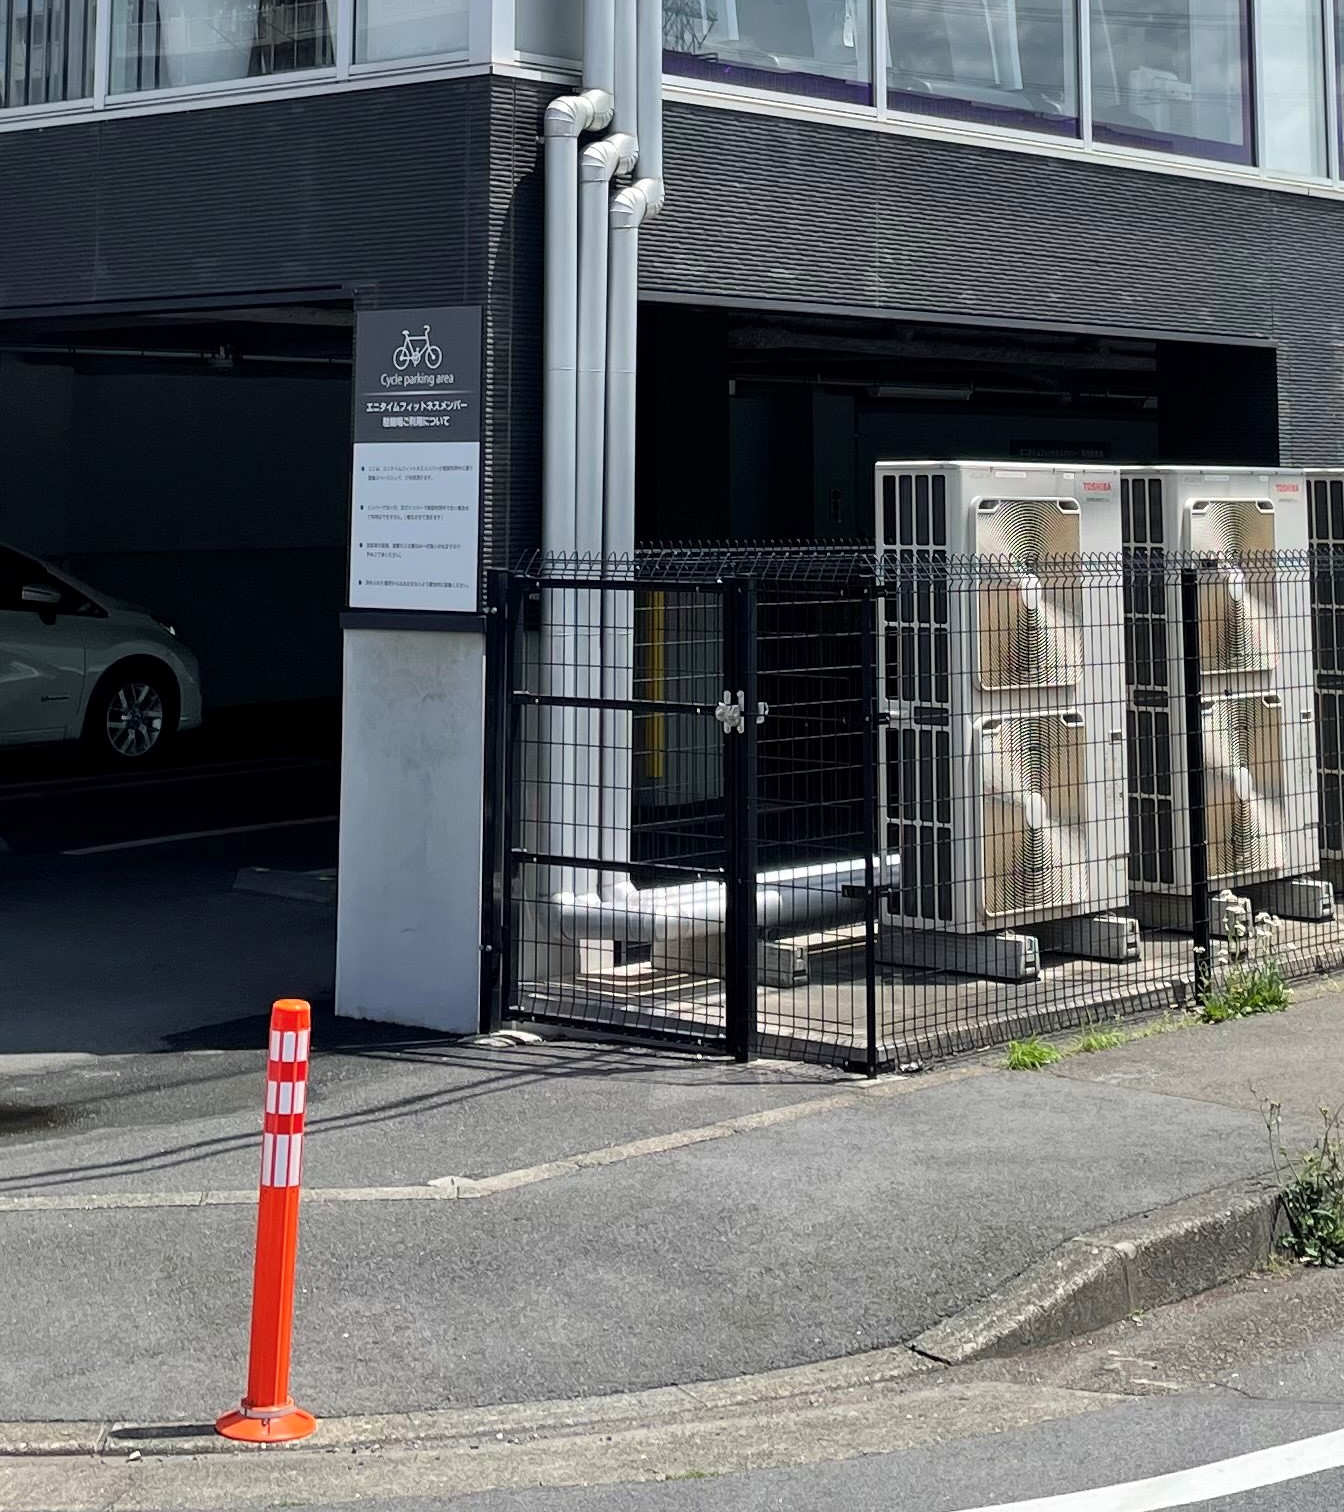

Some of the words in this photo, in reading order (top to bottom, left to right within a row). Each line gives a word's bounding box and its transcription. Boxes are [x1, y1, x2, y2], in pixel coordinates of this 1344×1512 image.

[381, 374, 402, 388] Cycle
[404, 373, 434, 387] parking
[436, 374, 453, 384] area
[366, 400, 467, 412] エニタイムフィットネスメンバー
